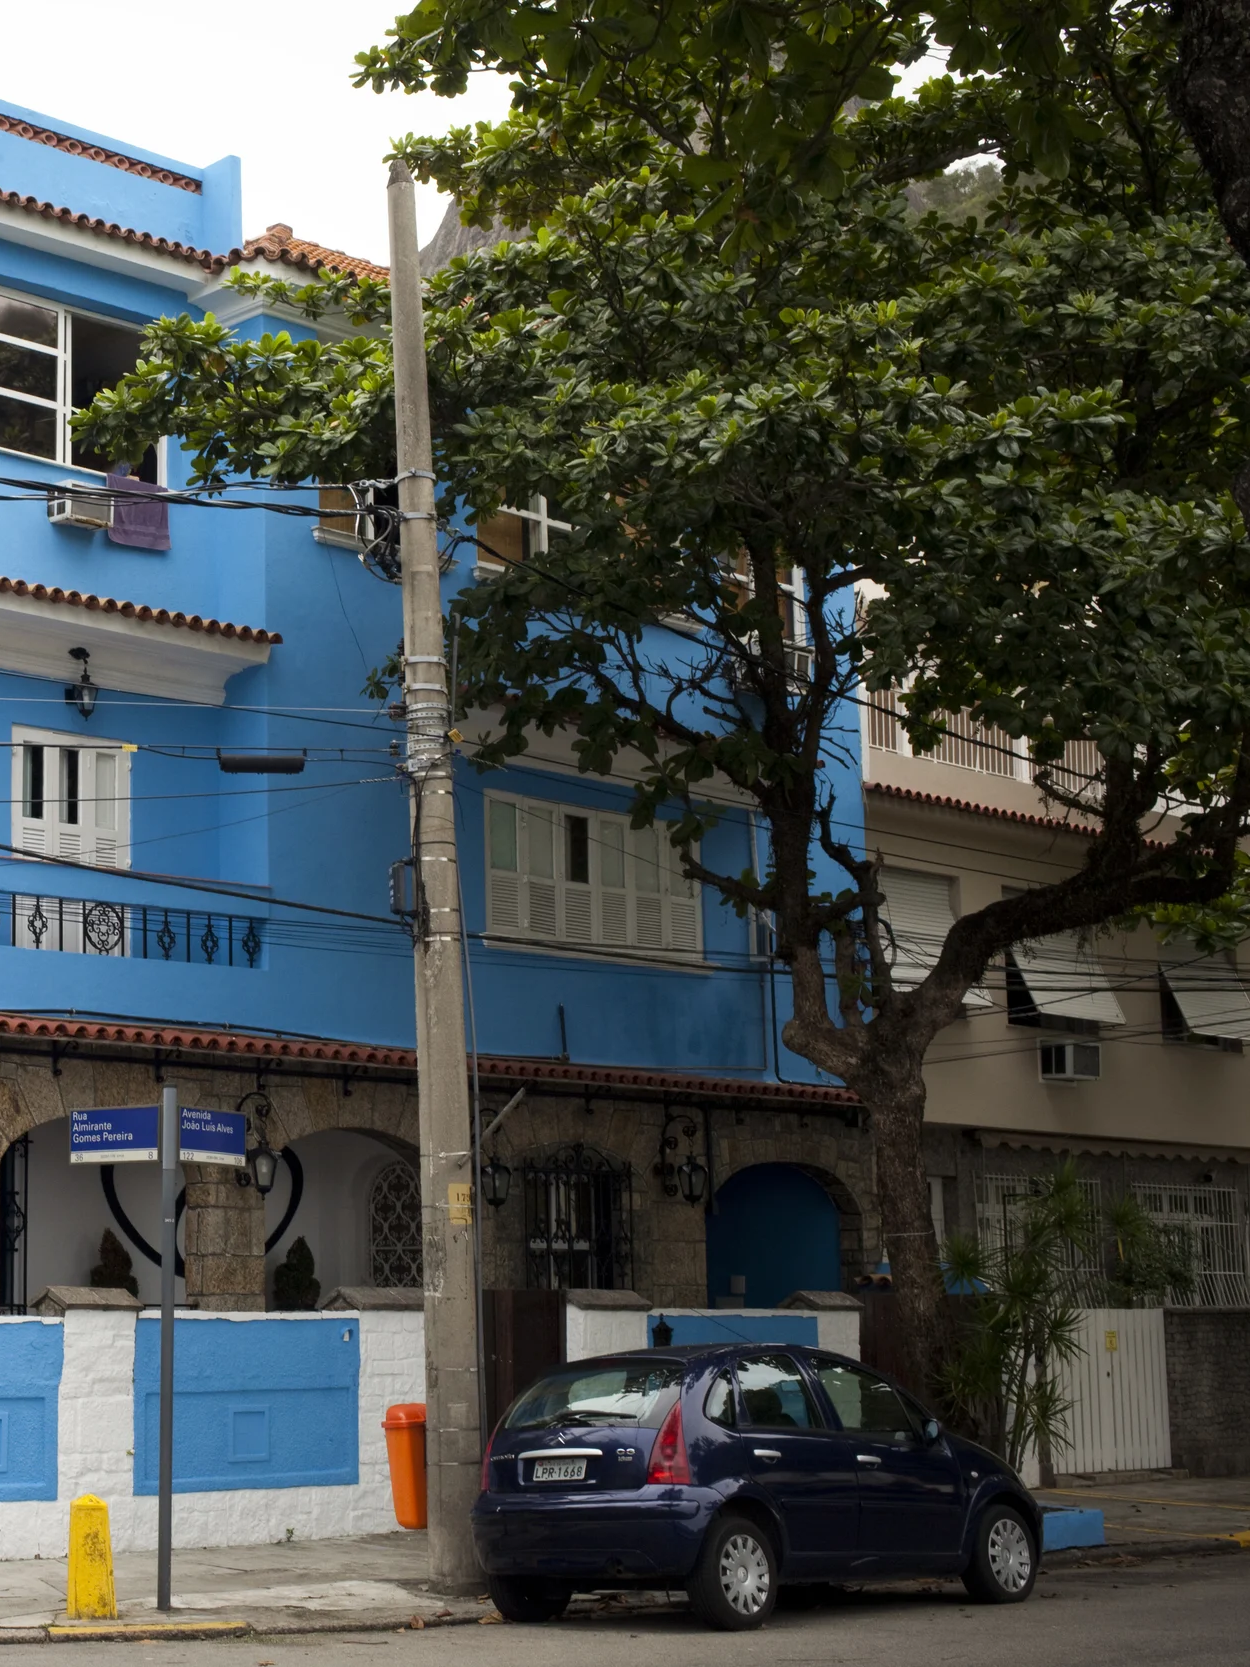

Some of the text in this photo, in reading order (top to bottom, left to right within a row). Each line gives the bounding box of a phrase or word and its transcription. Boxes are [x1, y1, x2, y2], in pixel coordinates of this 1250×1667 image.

[72, 1111, 88, 1121] Rua
[182, 1108, 211, 1120] Avenida
[72, 1121, 112, 1132] Almirante
[181, 1119, 200, 1130] João
[216, 1122, 234, 1134] Alves
[72, 1131, 133, 1143] Gomes Pereira
[74, 1153, 84, 1162] 36
[147, 1151, 154, 1160] 8
[182, 1151, 195, 1161] 122
